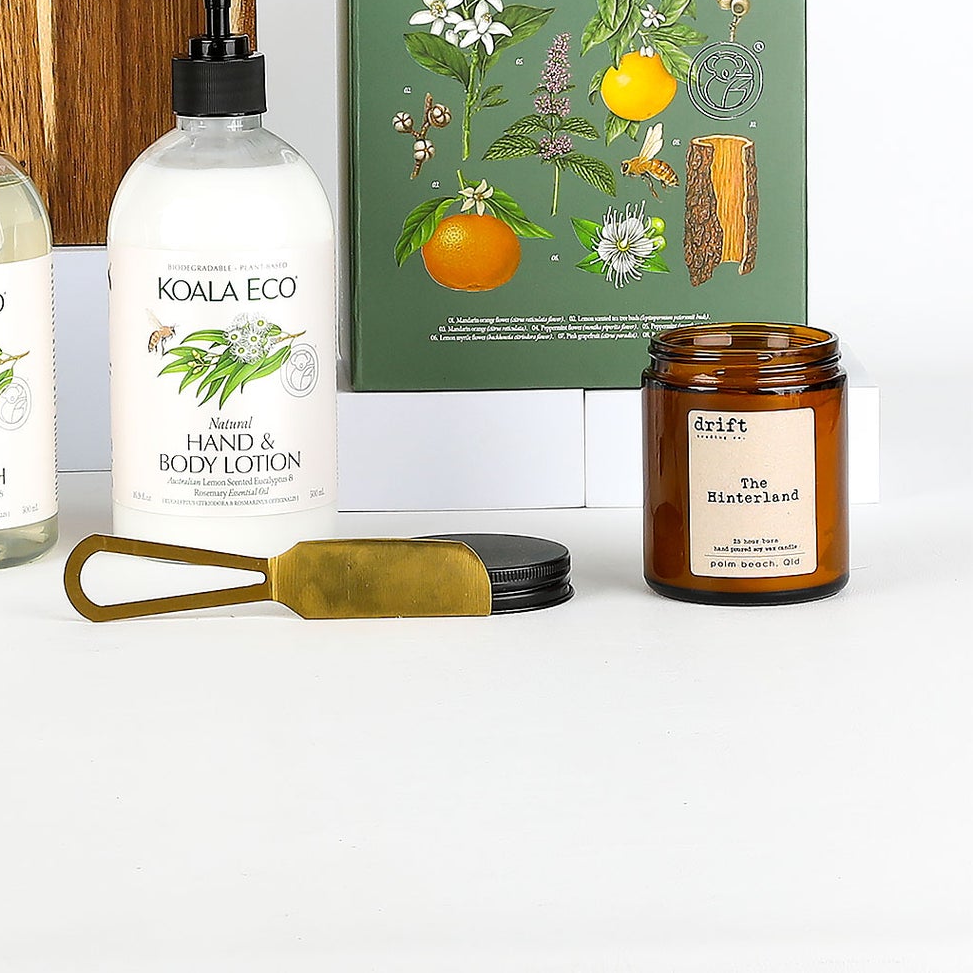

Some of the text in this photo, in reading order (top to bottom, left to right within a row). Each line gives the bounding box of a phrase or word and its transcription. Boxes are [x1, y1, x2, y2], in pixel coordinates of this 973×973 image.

[168, 264, 231, 272] BIODEGRADABLE
[158, 276, 296, 302] KOALA ECO
[208, 416, 253, 430] Natural
[694, 416, 747, 432] drift
[187, 432, 275, 452] HAND &
[159, 451, 301, 474] BODY LOTION
[168, 477, 201, 486] Australian
[202, 478, 226, 486] Lemon
[227, 477, 252, 486] Scented
[740, 478, 768, 488] The
[194, 488, 227, 499] Rosemary
[228, 488, 258, 497] Essential
[708, 488, 800, 504] Hinterland
[783, 558, 800, 566] Qld
